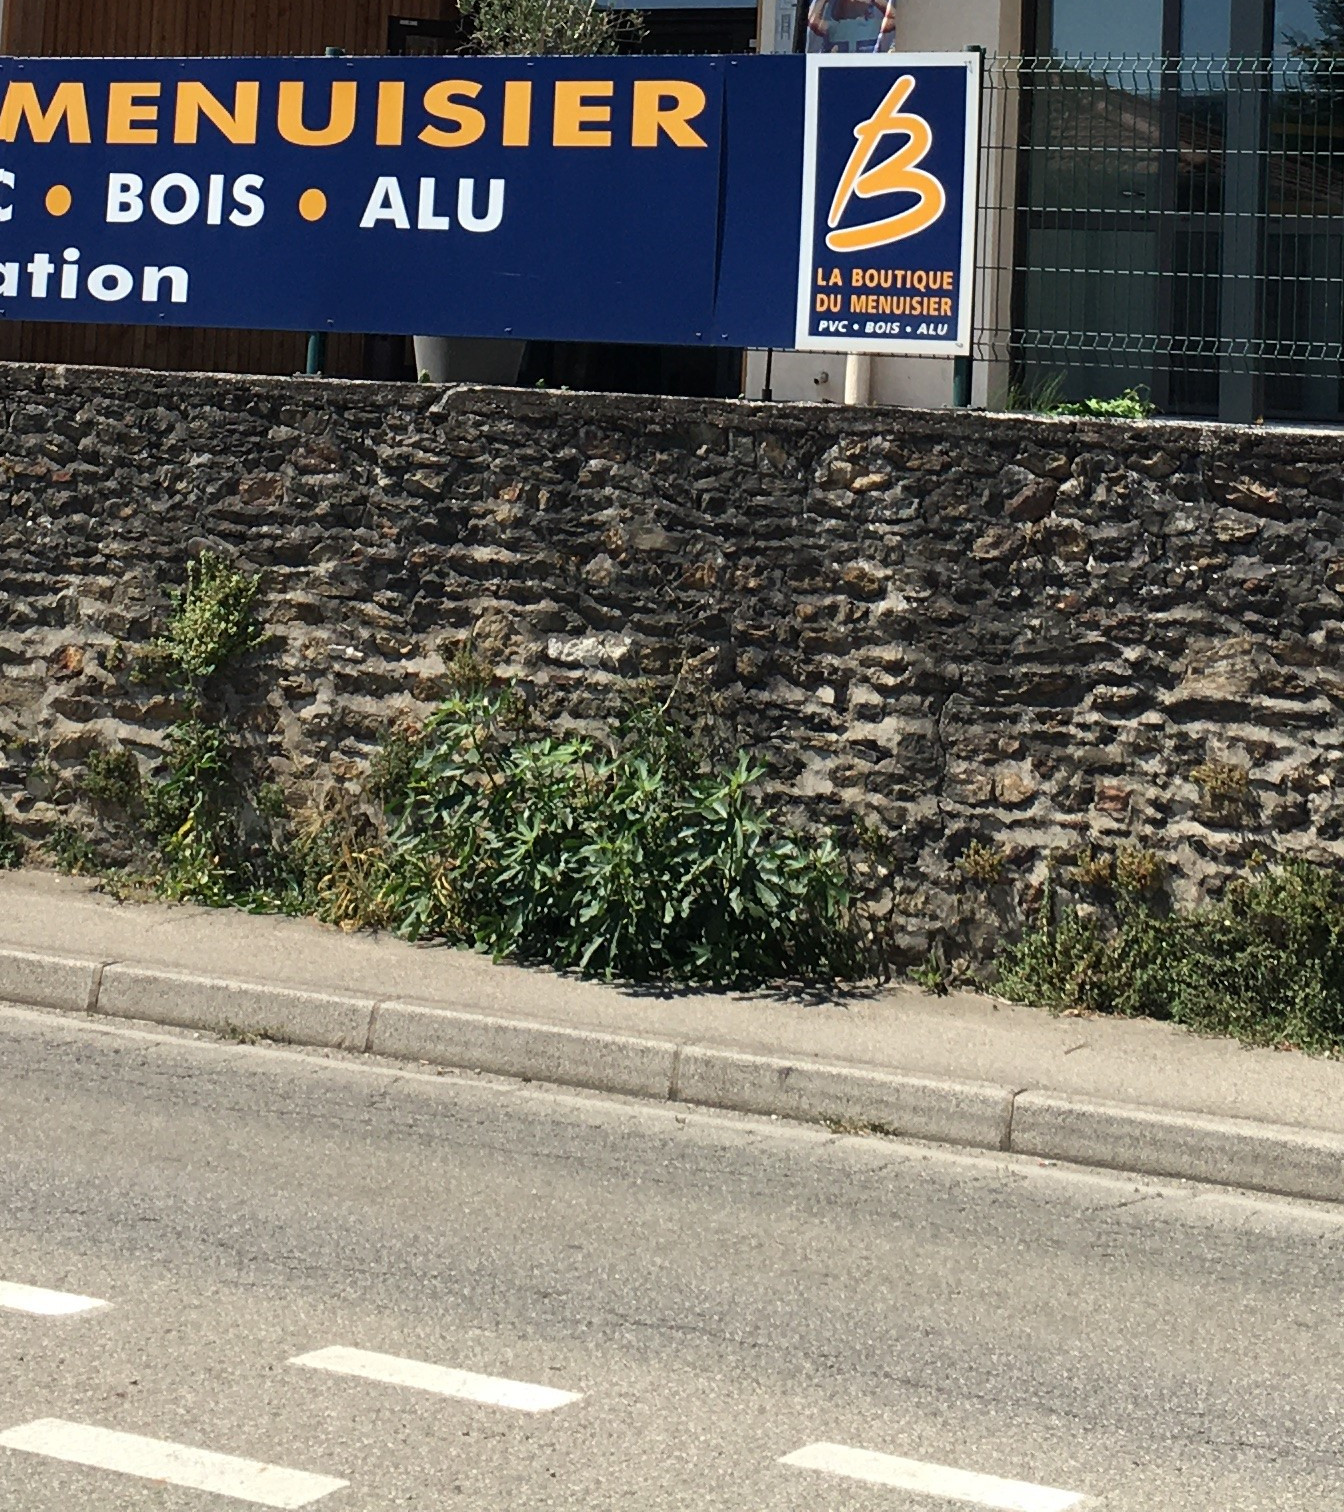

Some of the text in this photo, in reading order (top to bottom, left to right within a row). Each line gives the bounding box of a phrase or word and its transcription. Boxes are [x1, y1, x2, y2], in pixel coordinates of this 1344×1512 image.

[106, 171, 265, 227] BOIS
[359, 176, 506, 232] ALU
[817, 267, 954, 292] LA BOUTIQUE
[815, 294, 952, 316] DU MENUISIER
[818, 320, 948, 336] PVC BOIS ALU
